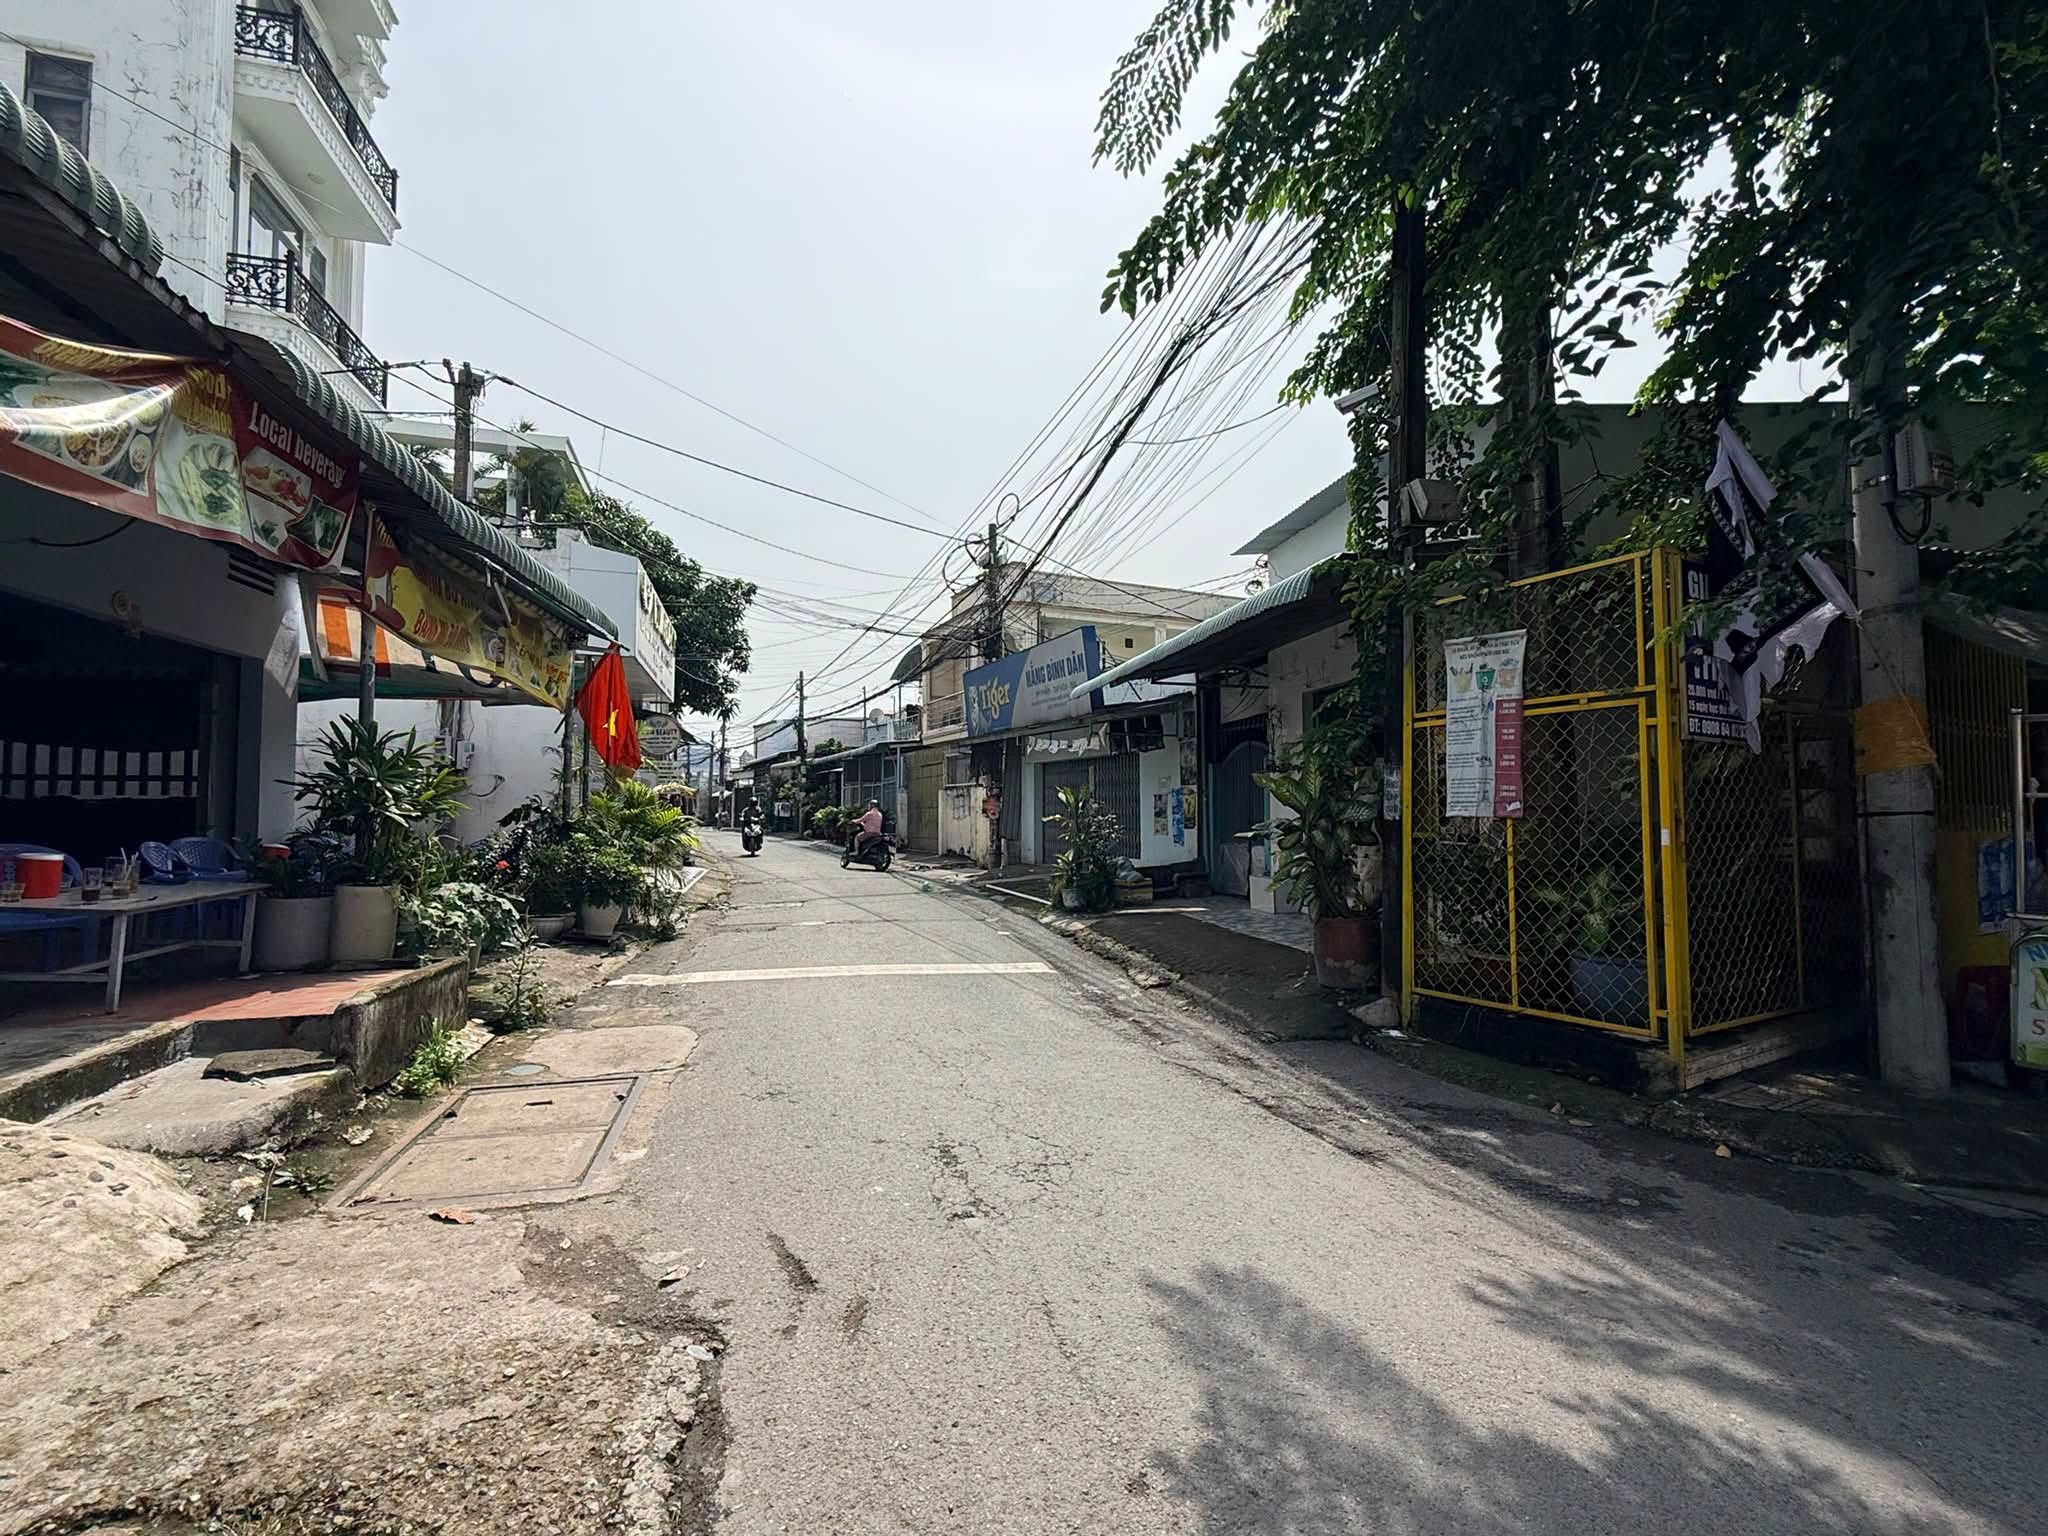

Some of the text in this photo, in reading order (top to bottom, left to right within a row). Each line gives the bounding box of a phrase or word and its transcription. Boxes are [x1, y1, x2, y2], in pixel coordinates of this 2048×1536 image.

[248, 401, 293, 452] Local
[1046, 658, 1066, 681] BÌNH
[1066, 650, 1085, 676] DÂN
[978, 677, 1010, 720] Tiger
